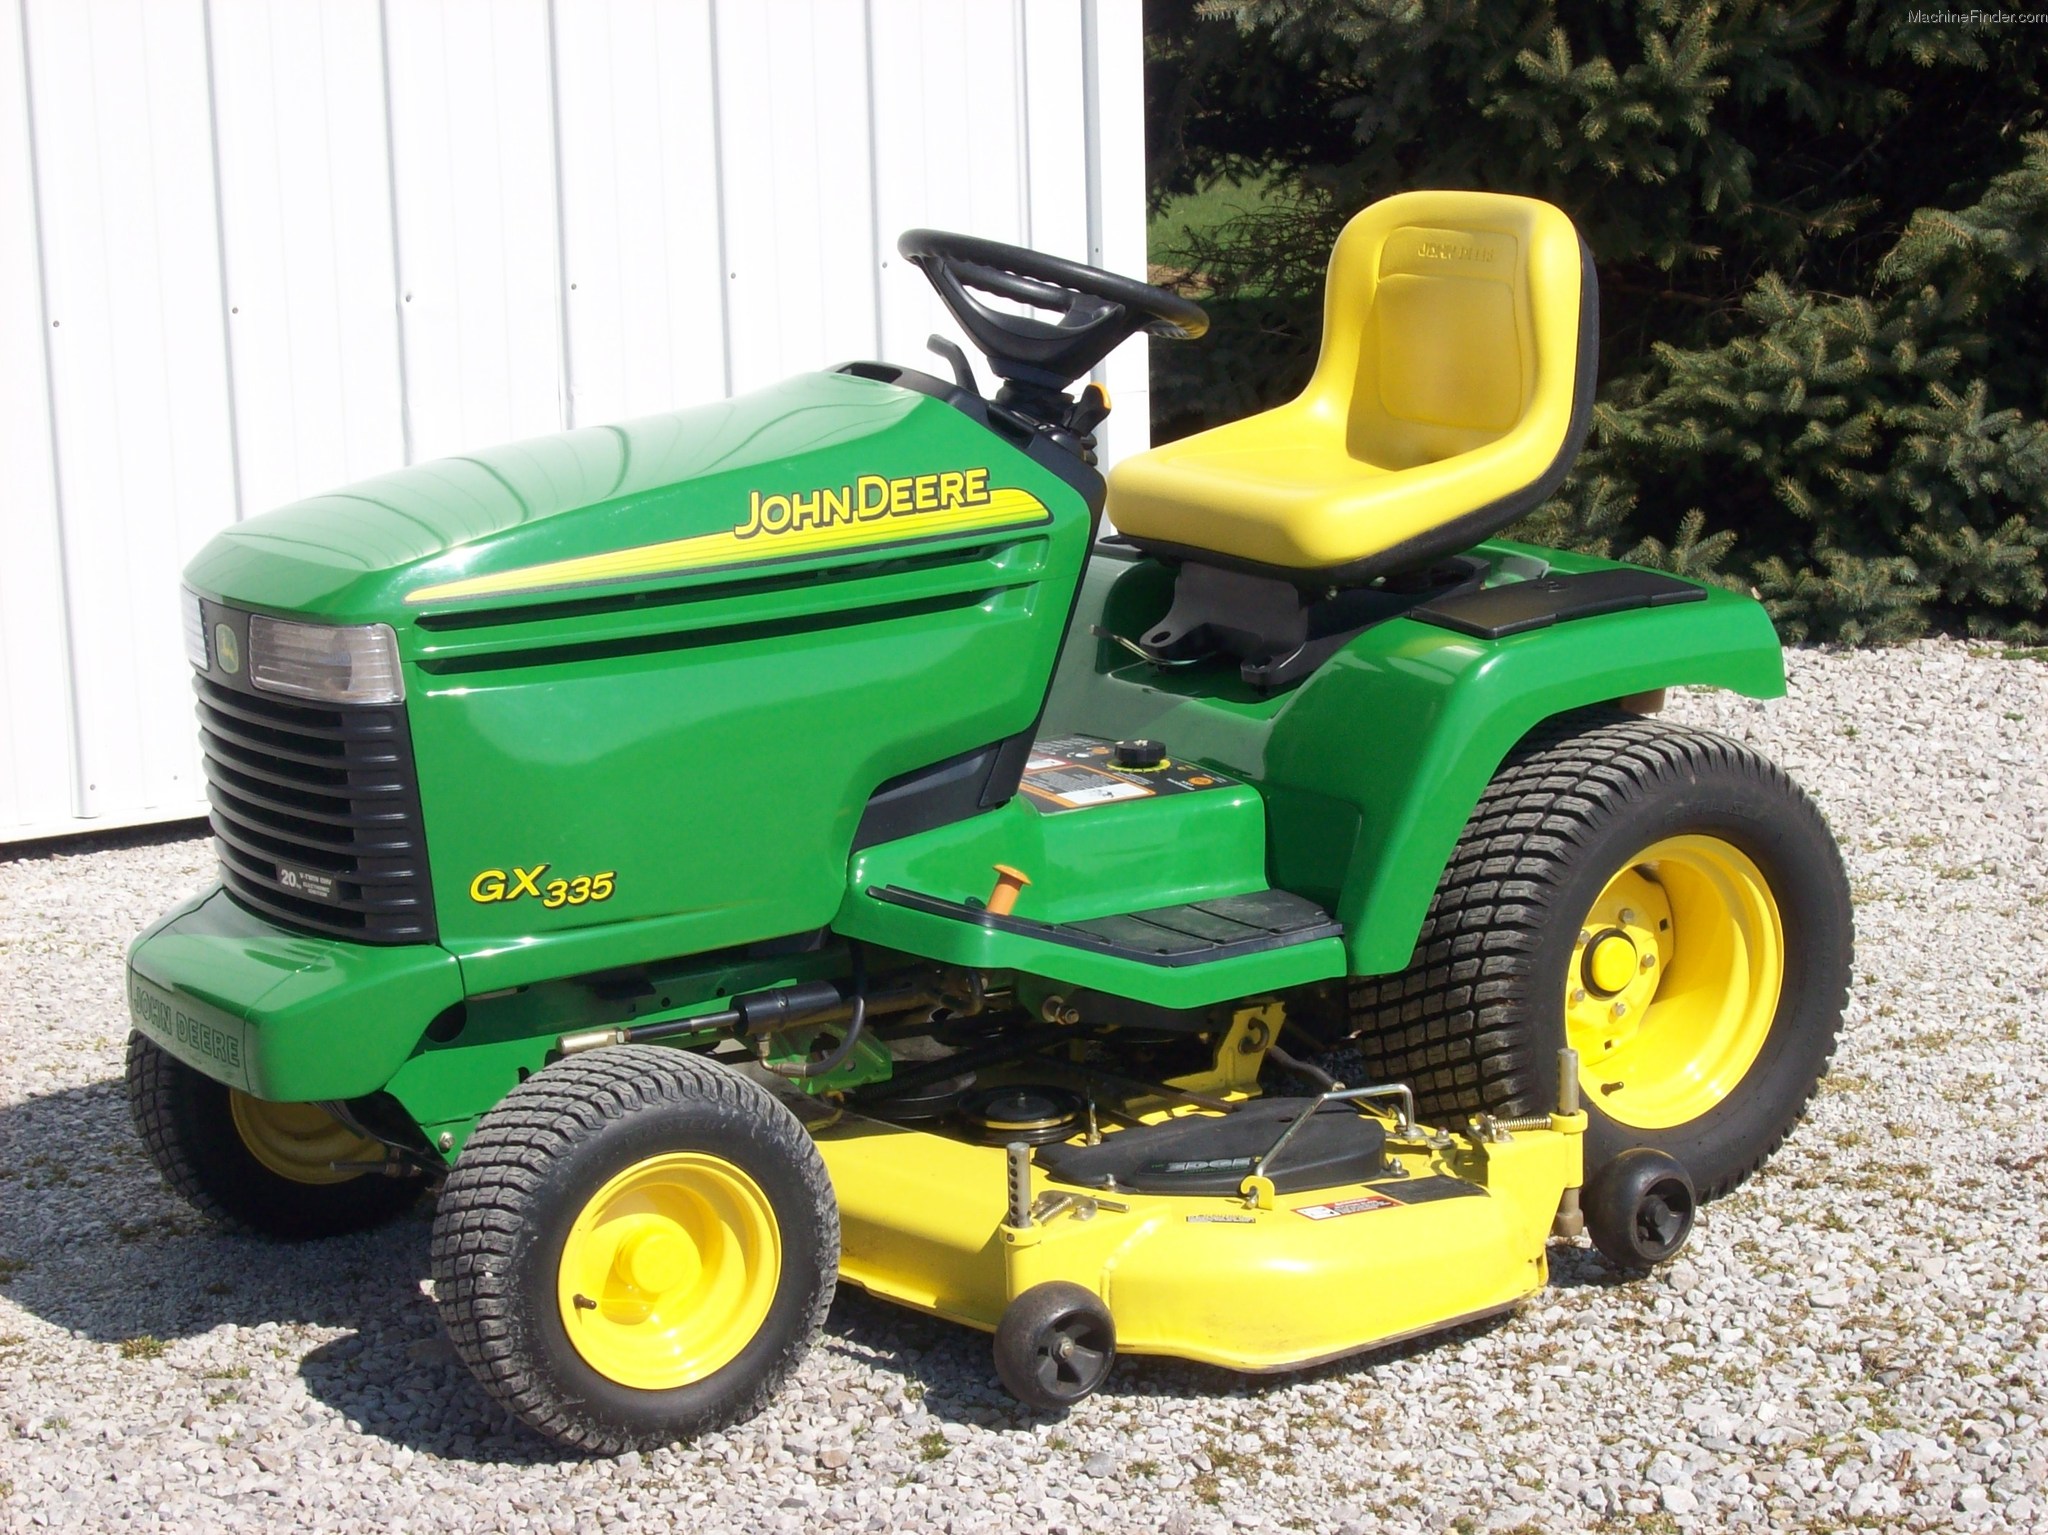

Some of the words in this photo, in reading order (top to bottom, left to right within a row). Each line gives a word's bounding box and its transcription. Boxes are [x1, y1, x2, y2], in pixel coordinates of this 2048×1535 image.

[734, 485, 852, 539] JOHN
[857, 467, 989, 521] DEERE
[281, 869, 297, 888] 20
[134, 986, 172, 1036] JOHN
[176, 1011, 240, 1068] DEERE
